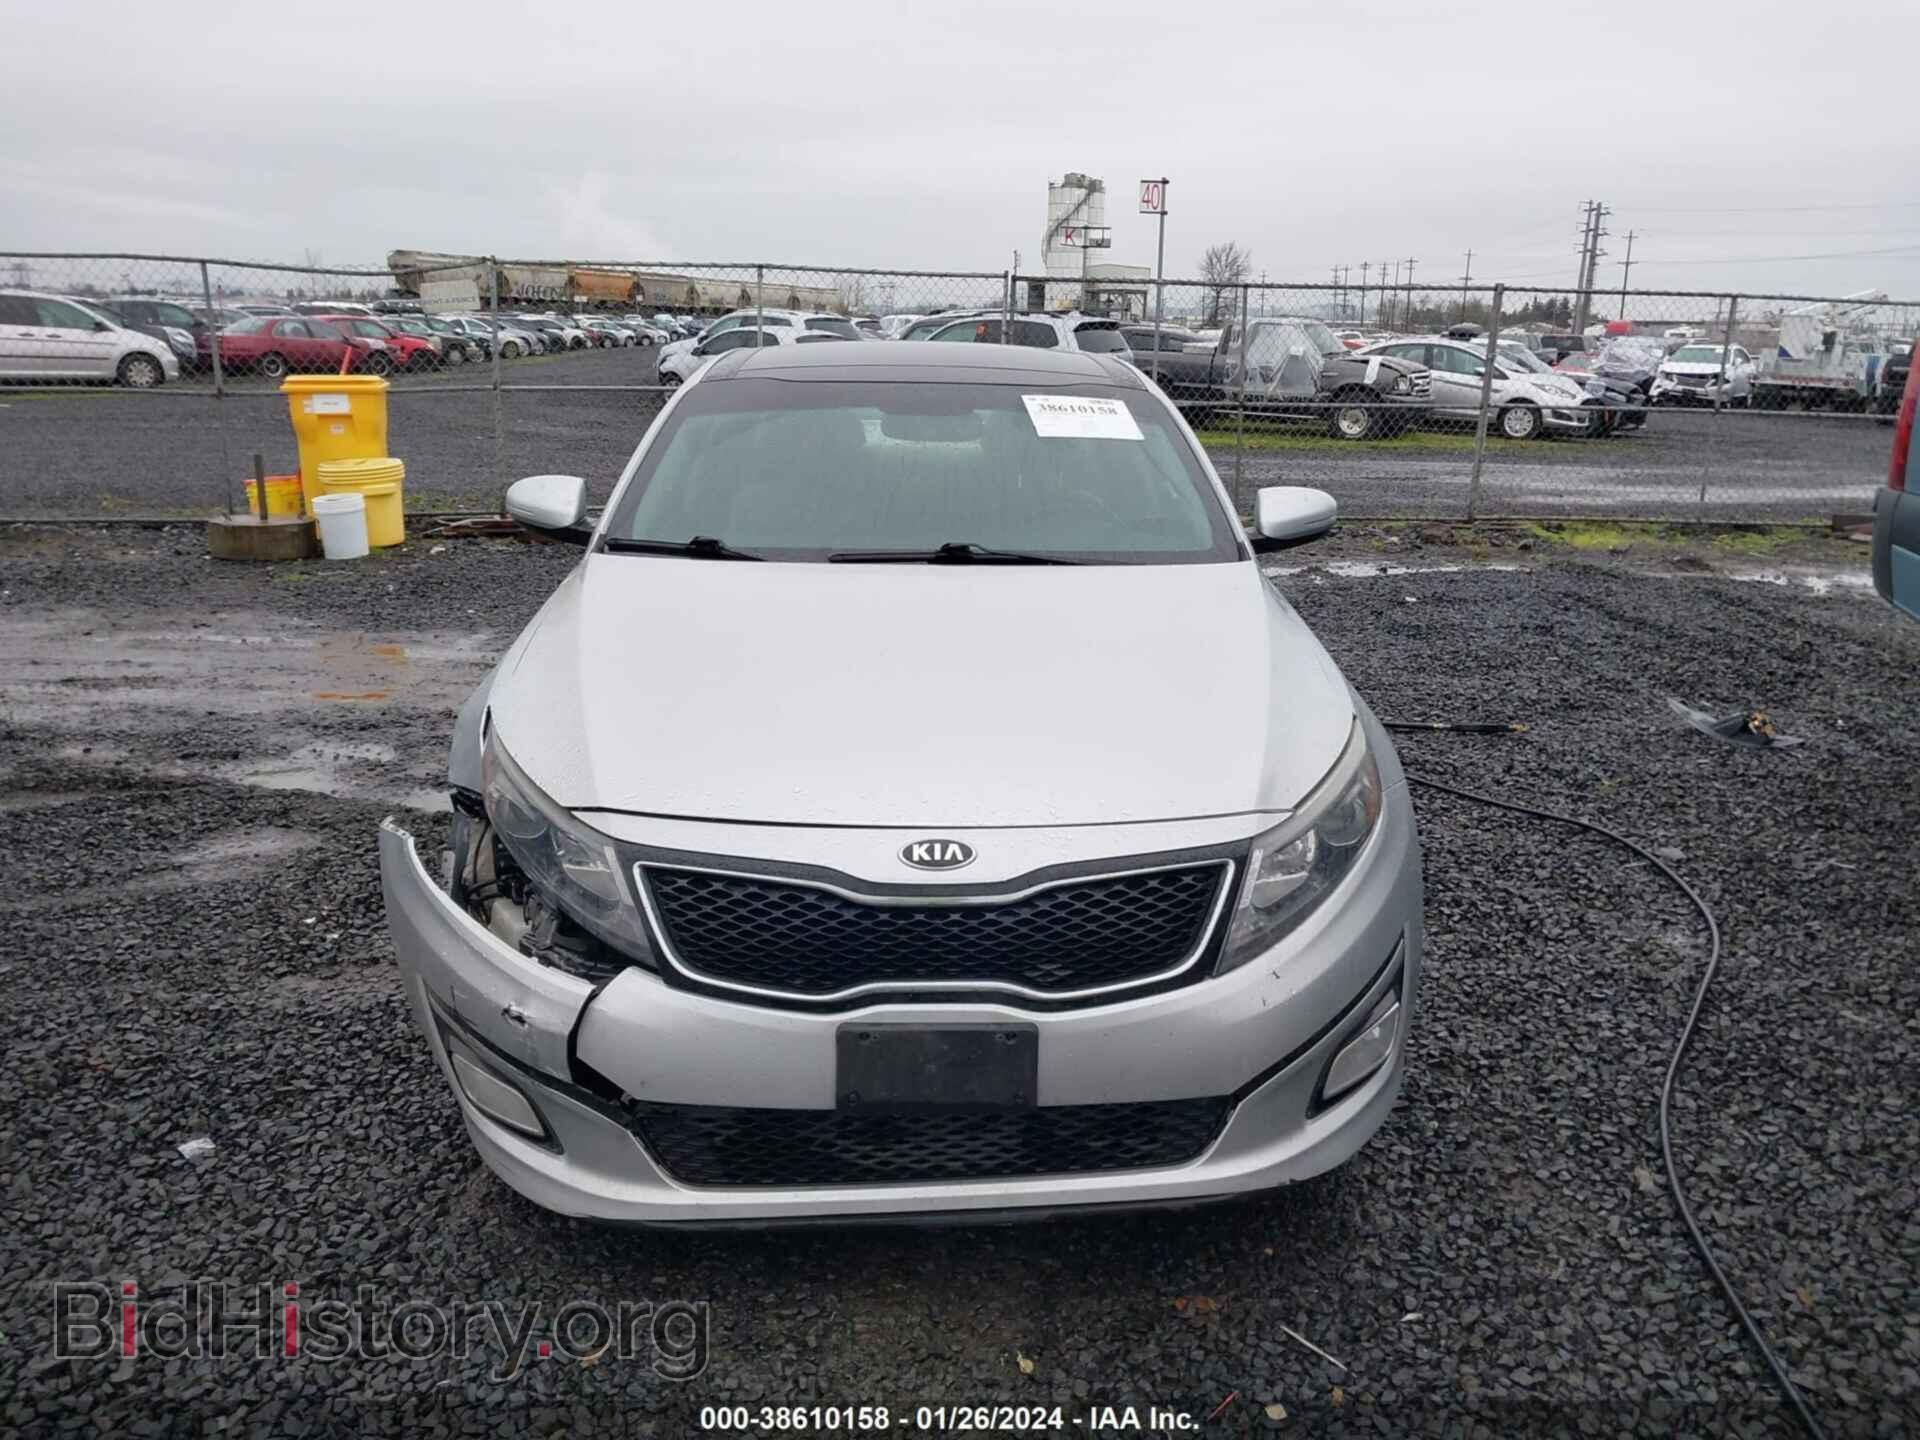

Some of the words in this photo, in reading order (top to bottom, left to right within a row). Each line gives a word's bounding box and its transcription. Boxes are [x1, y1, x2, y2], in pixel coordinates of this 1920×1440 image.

[1142, 184, 1160, 210] 40
[1064, 227, 1077, 247] K
[912, 842, 964, 861] KIA
